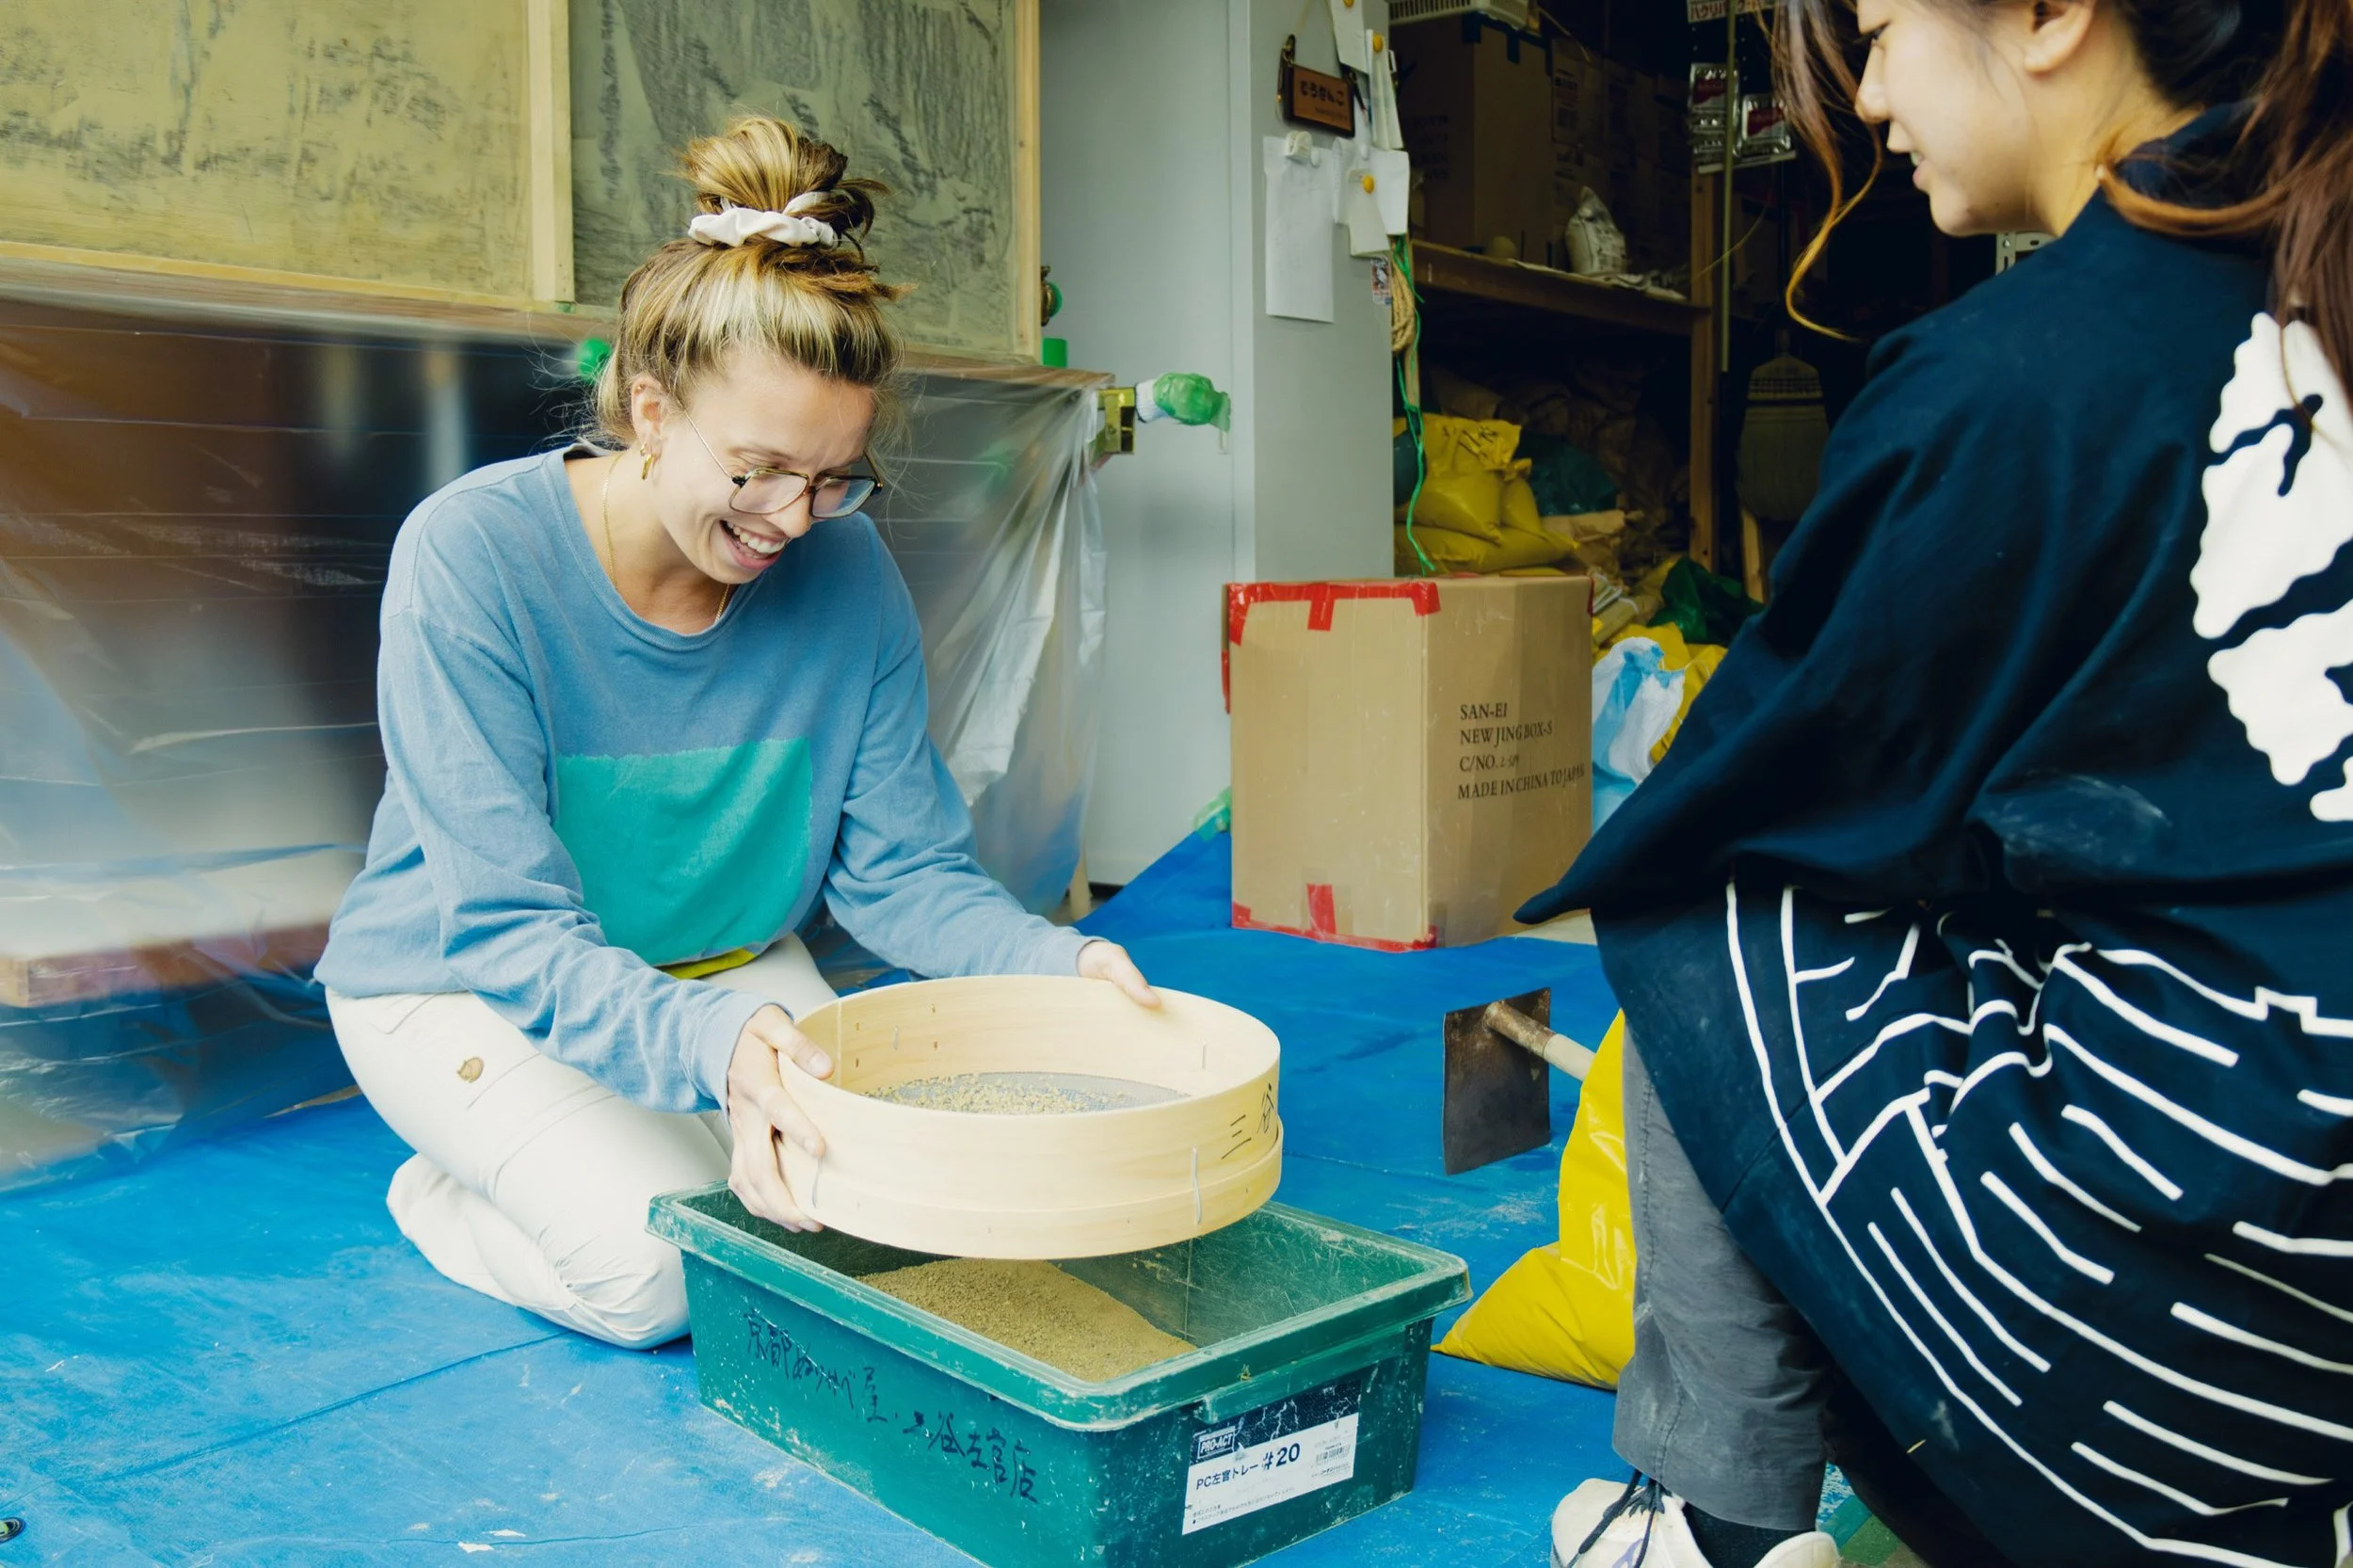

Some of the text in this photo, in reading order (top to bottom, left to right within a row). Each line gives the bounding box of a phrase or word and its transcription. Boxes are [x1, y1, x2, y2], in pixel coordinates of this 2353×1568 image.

[1460, 702, 1508, 720] SAN-EI
[1460, 727, 1494, 745] NEW
[1460, 754, 1498, 772] C/NO.
[1458, 779, 1497, 800] MADE
[1500, 778, 1514, 796] IN
[1516, 773, 1548, 792] CHINA
[1549, 769, 1562, 786] TO
[1199, 1432, 1233, 1455] PRO-ACT
[1196, 1464, 1258, 1490] PC左官トレー
[1262, 1442, 1301, 1471] #20
